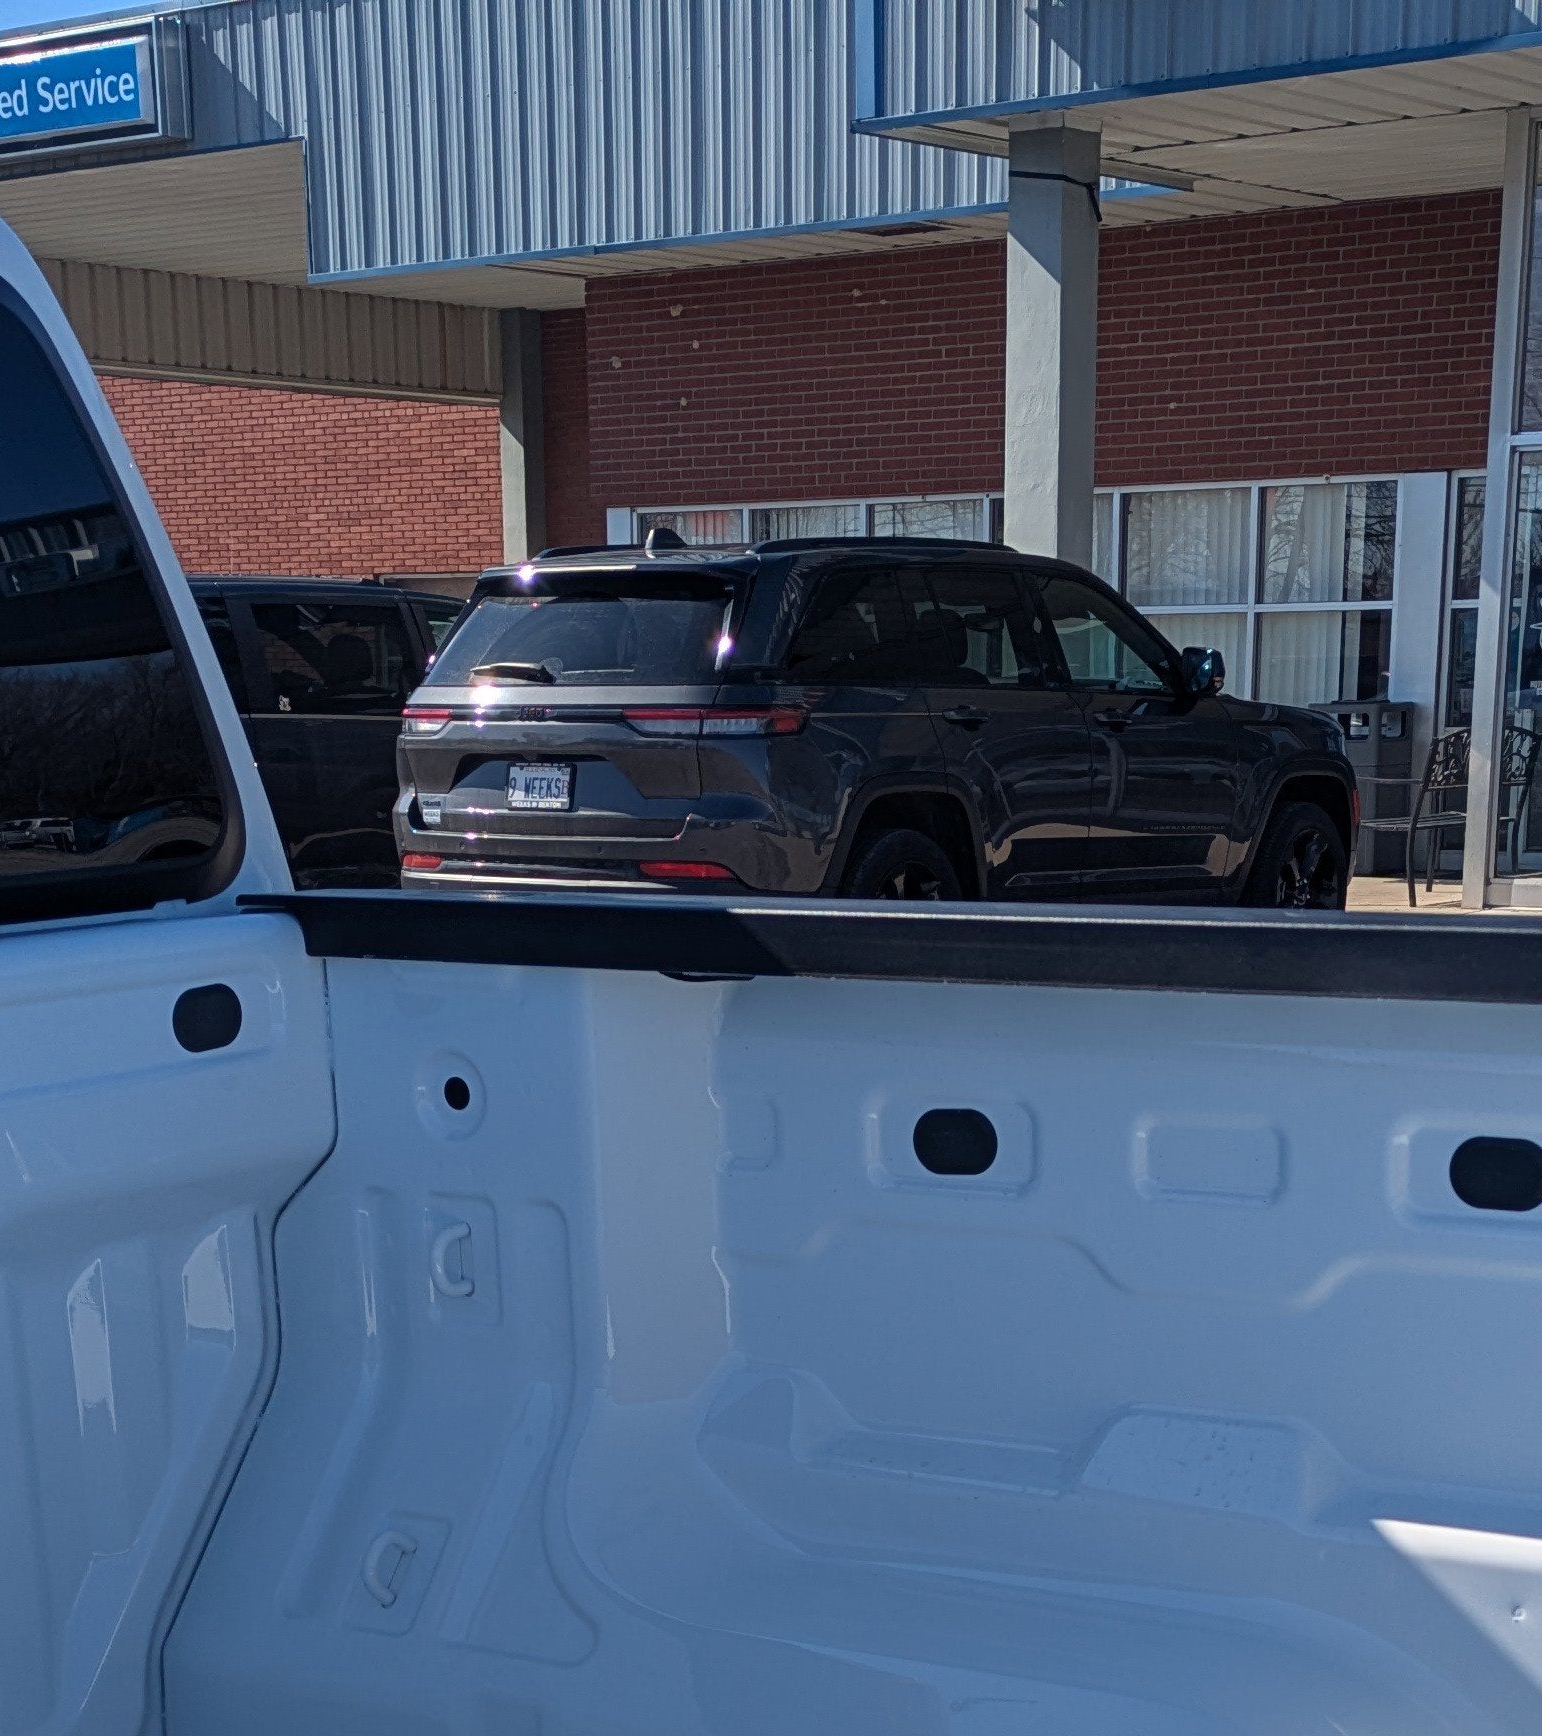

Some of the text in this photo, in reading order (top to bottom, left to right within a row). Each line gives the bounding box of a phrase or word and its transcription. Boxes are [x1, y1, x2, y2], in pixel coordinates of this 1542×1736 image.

[37, 67, 135, 113] Service
[509, 776, 517, 798] 9
[524, 776, 561, 799] WEEKS
